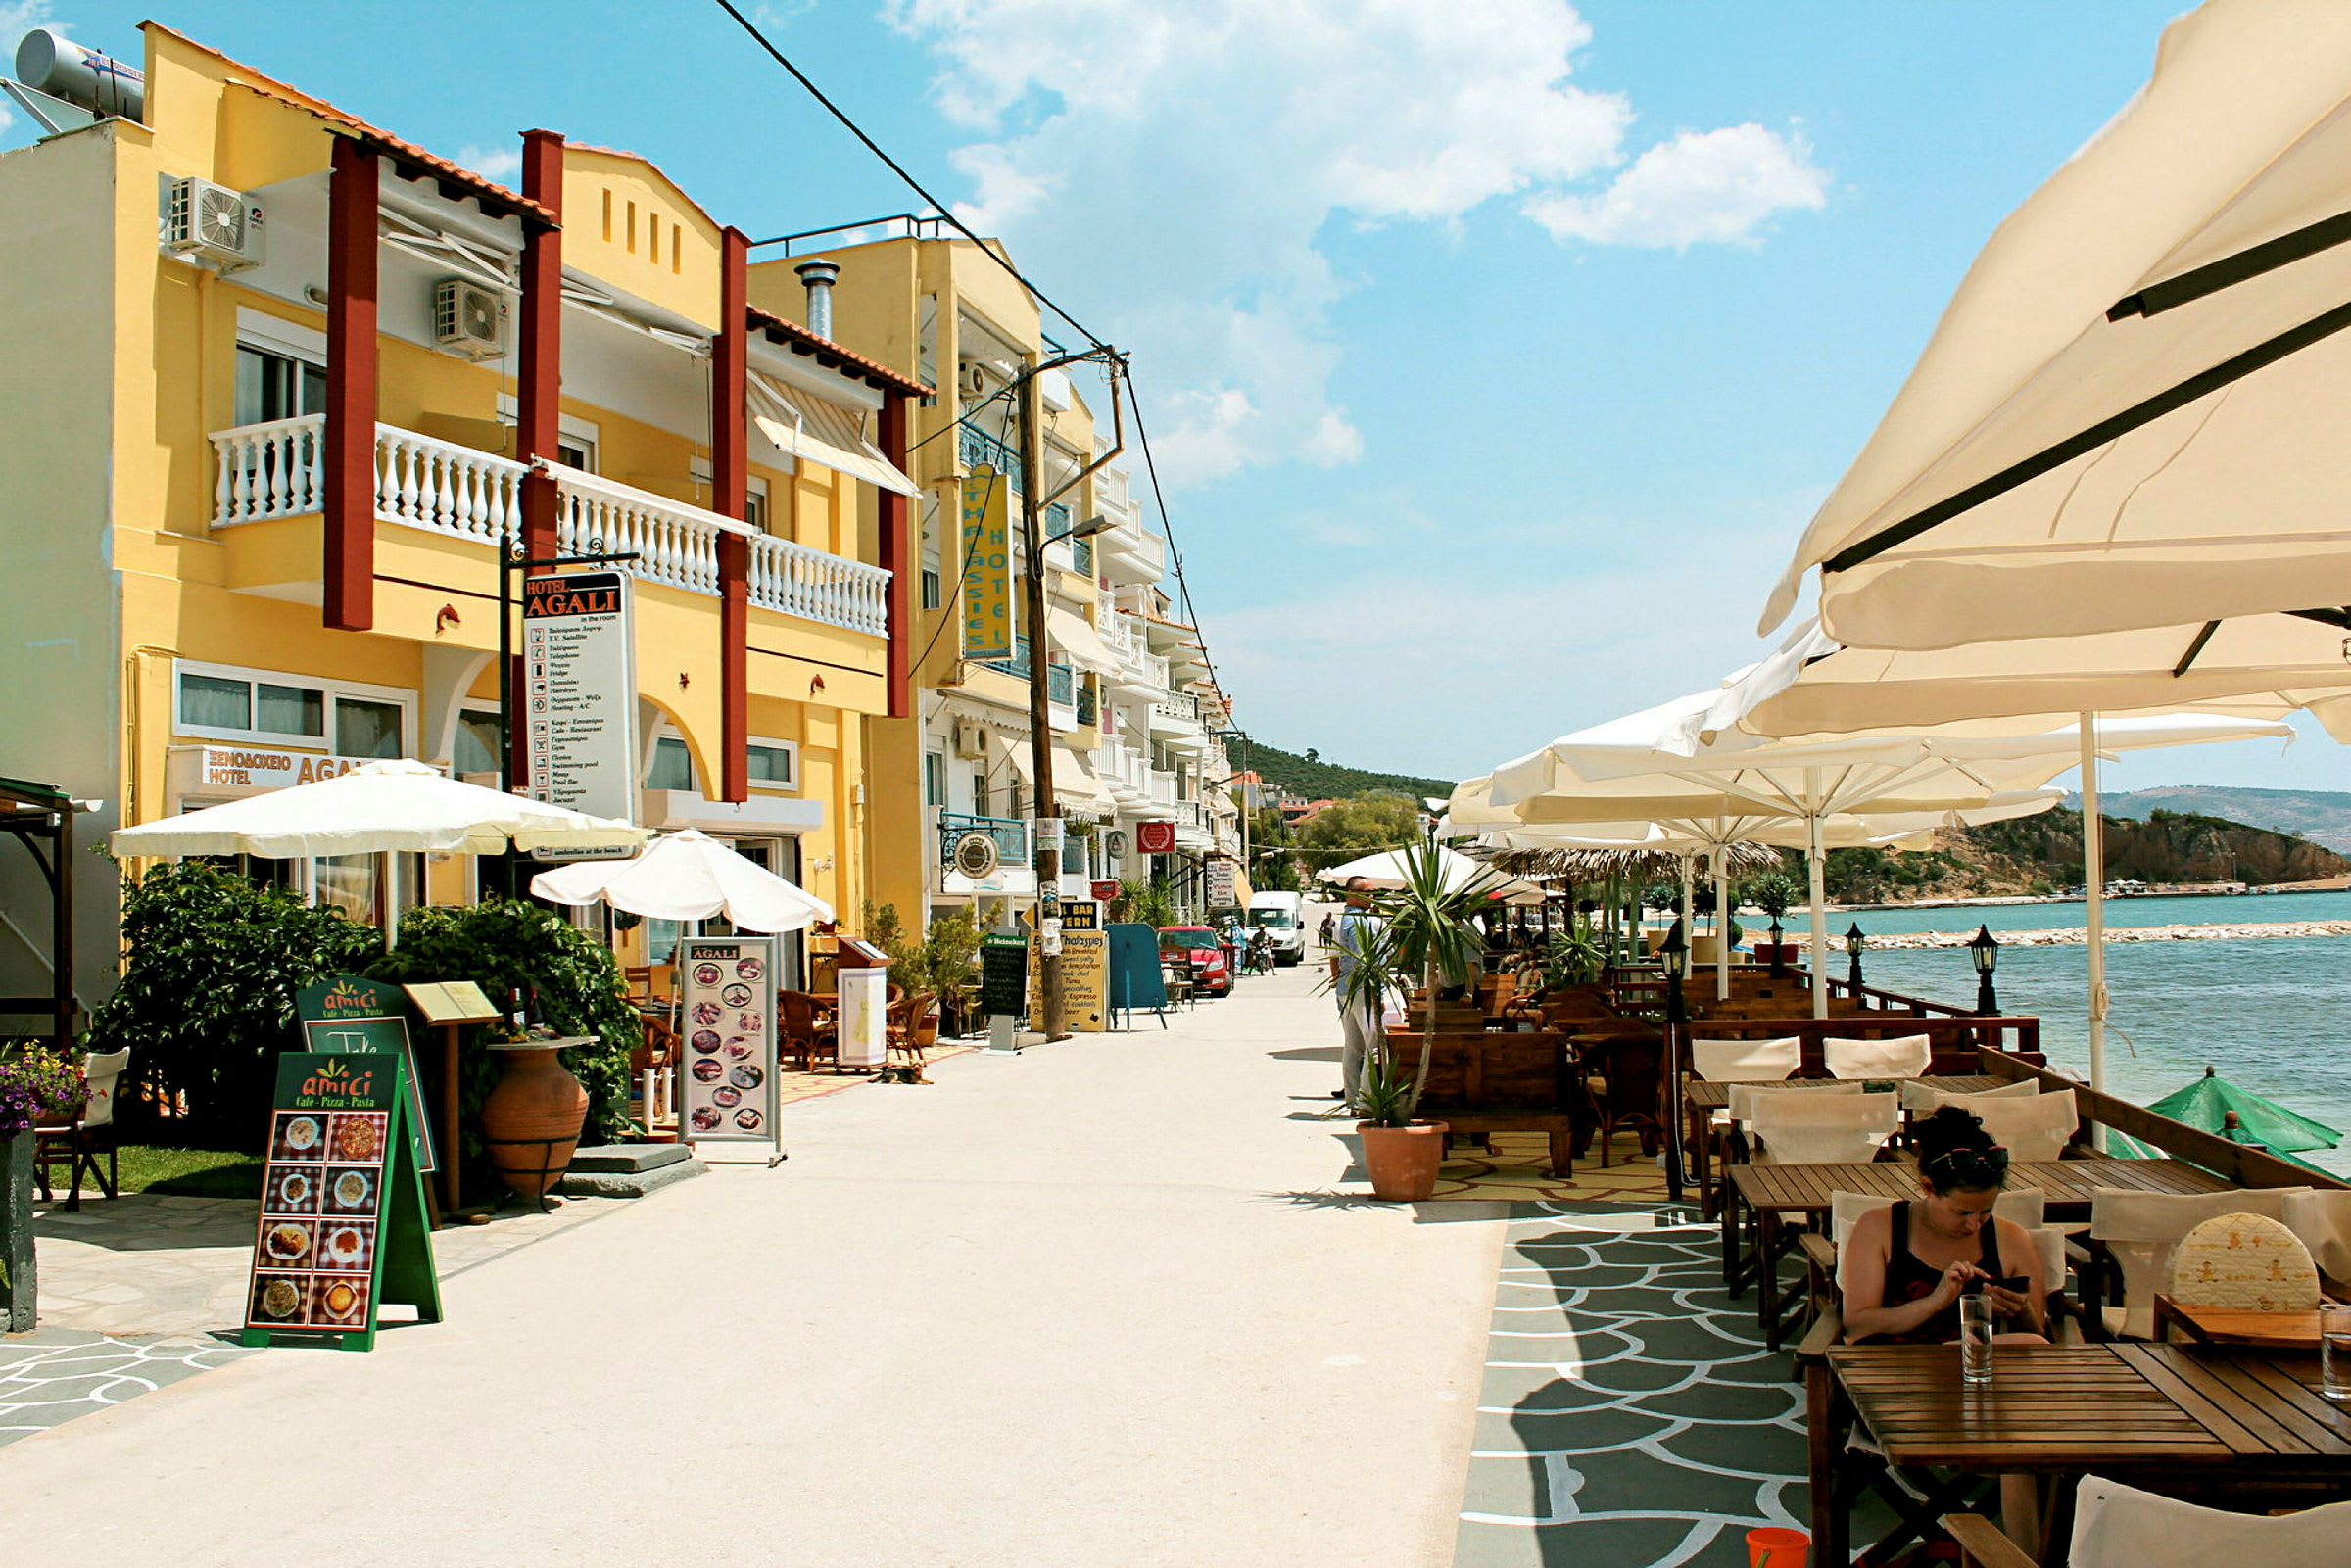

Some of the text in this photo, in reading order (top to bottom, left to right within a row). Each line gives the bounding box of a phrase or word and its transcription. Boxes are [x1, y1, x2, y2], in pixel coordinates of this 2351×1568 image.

[526, 579, 570, 595] HOTEL
[988, 529, 1006, 645] HOTEL
[526, 591, 616, 617] AGALI
[209, 769, 252, 784] HOTEL
[1073, 905, 1093, 915] BAR
[694, 949, 737, 959] AGALI
[324, 989, 377, 1009] amici
[302, 1070, 373, 1096] amici
[321, 1096, 344, 1108] Pizza
[351, 1096, 374, 1107] Pasta
